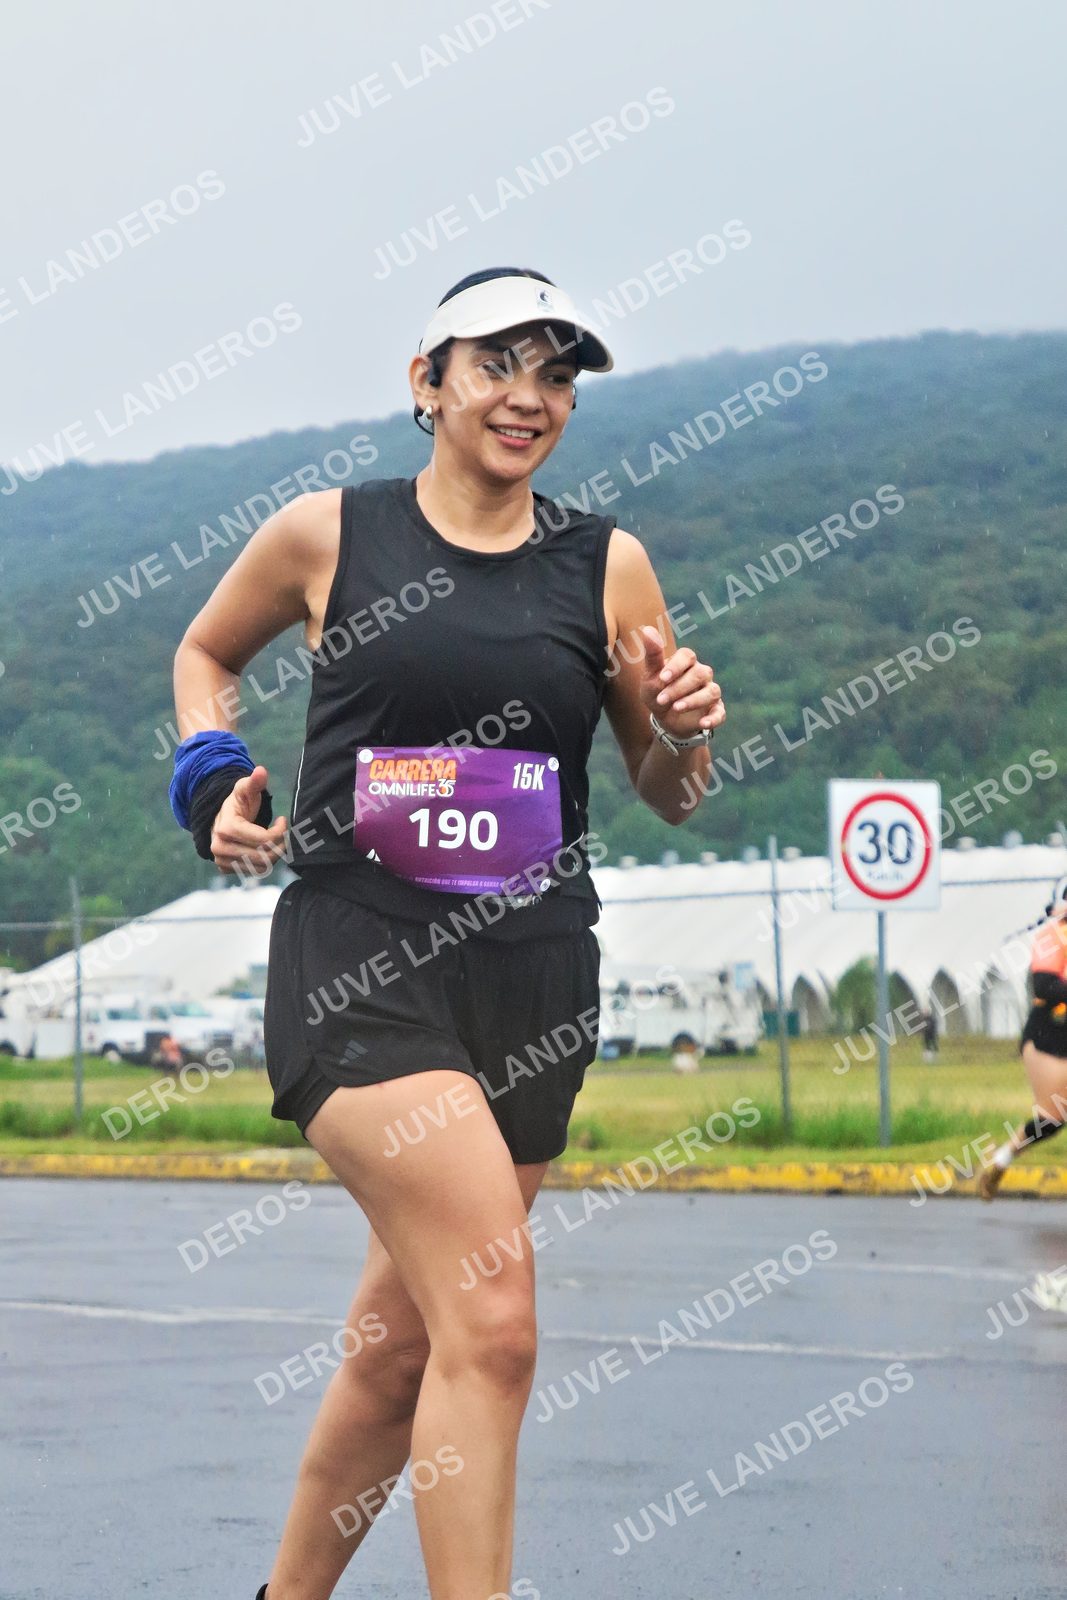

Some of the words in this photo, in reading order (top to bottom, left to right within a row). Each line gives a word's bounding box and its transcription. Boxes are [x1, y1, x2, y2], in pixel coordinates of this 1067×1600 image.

[369, 759, 457, 781] CARRERA
[512, 762, 545, 791] 15K
[368, 782, 436, 797] OMNILIFE
[408, 807, 499, 851] 190
[857, 822, 914, 865] 30
